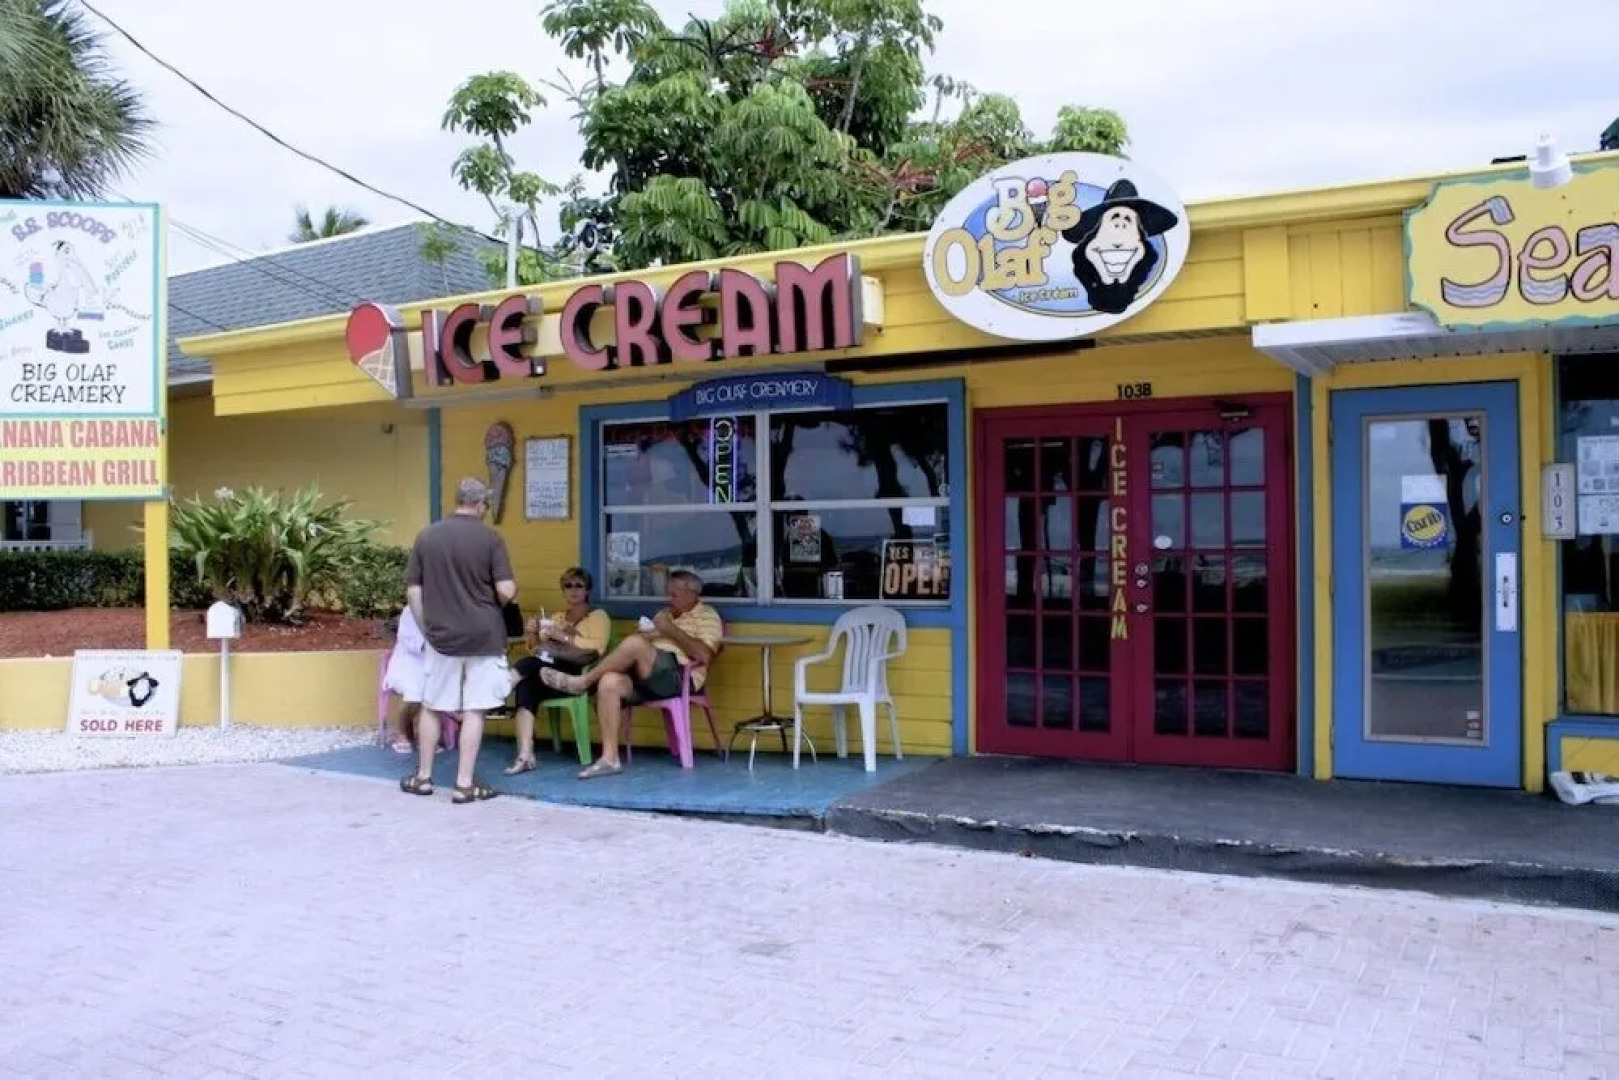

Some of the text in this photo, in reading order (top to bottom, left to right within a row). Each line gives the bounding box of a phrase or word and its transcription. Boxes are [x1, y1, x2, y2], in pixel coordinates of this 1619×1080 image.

[986, 170, 1081, 242] Big
[47, 212, 116, 244] SCOOPS
[933, 226, 1058, 296] Olaf
[422, 253, 860, 387] ICE CREAM
[22, 363, 117, 382] BIG OLAF
[11, 384, 126, 404] CREAMERY
[751, 379, 818, 398] CREAMERY
[0, 420, 159, 448] NANA CABANA
[0, 460, 159, 487] RIBBEAN GRILL
[715, 420, 733, 504] OPEN
[1111, 417, 1128, 640] ICE CREAM
[889, 546, 909, 561] YES
[80, 719, 163, 732] SOLD HERE
